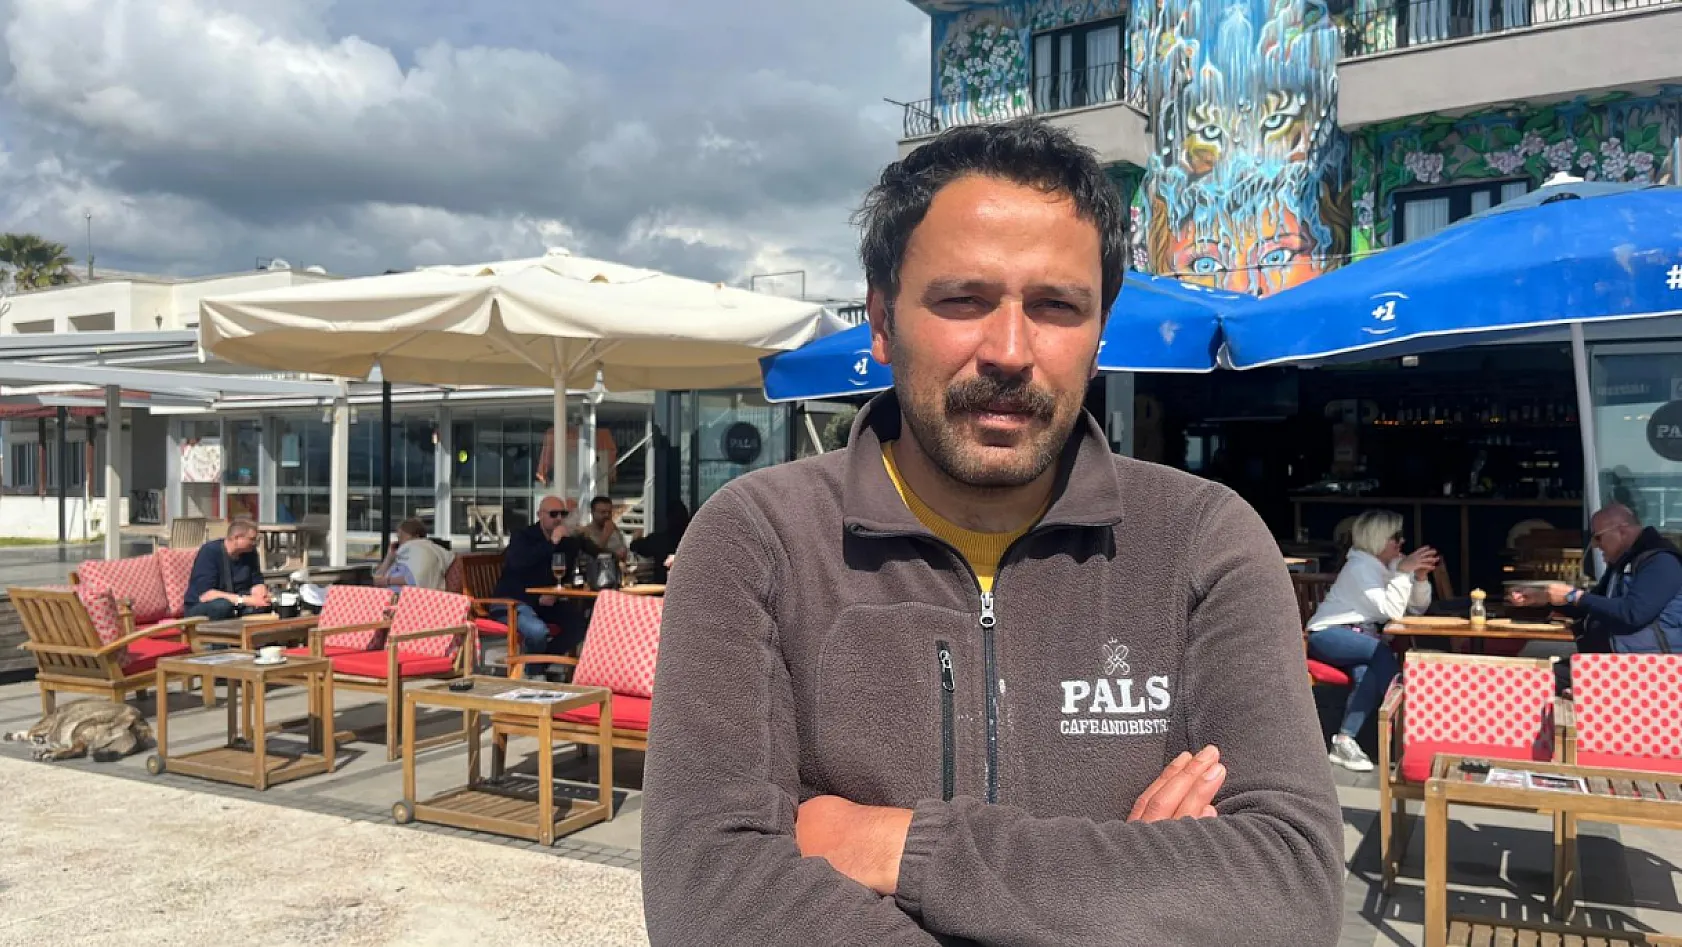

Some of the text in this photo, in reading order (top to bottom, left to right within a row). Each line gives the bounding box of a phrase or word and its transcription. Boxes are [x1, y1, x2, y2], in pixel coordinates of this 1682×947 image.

[1371, 300, 1396, 321] +1
[1061, 675, 1171, 713] PALS
[1060, 718, 1171, 735] CAFEANDBISTR
